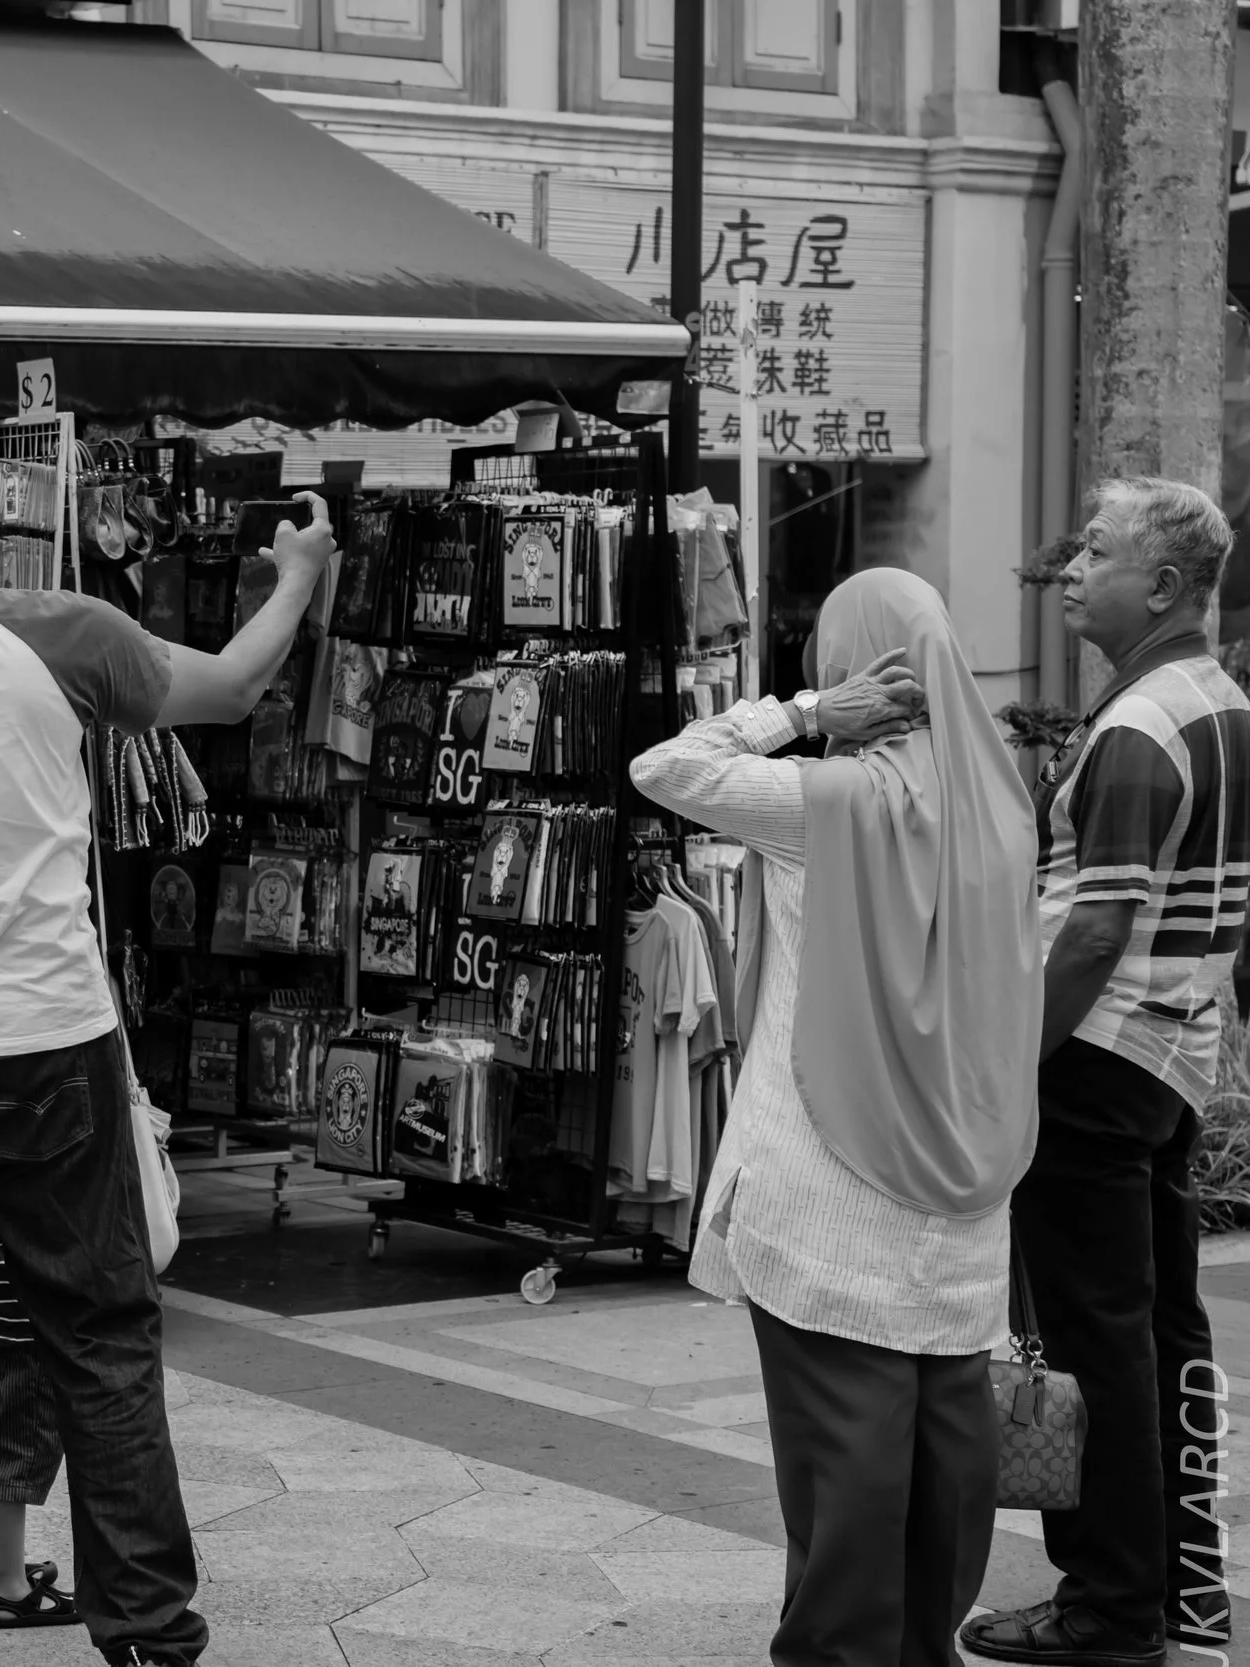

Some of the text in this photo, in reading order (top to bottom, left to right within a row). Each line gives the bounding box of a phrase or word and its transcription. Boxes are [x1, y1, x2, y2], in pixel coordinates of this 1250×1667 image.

[21, 371, 54, 414] $2
[435, 747, 483, 805] SG
[453, 931, 500, 990] SG
[327, 1067, 368, 1104] SINGAPORE
[327, 1119, 363, 1143] LION CITY
